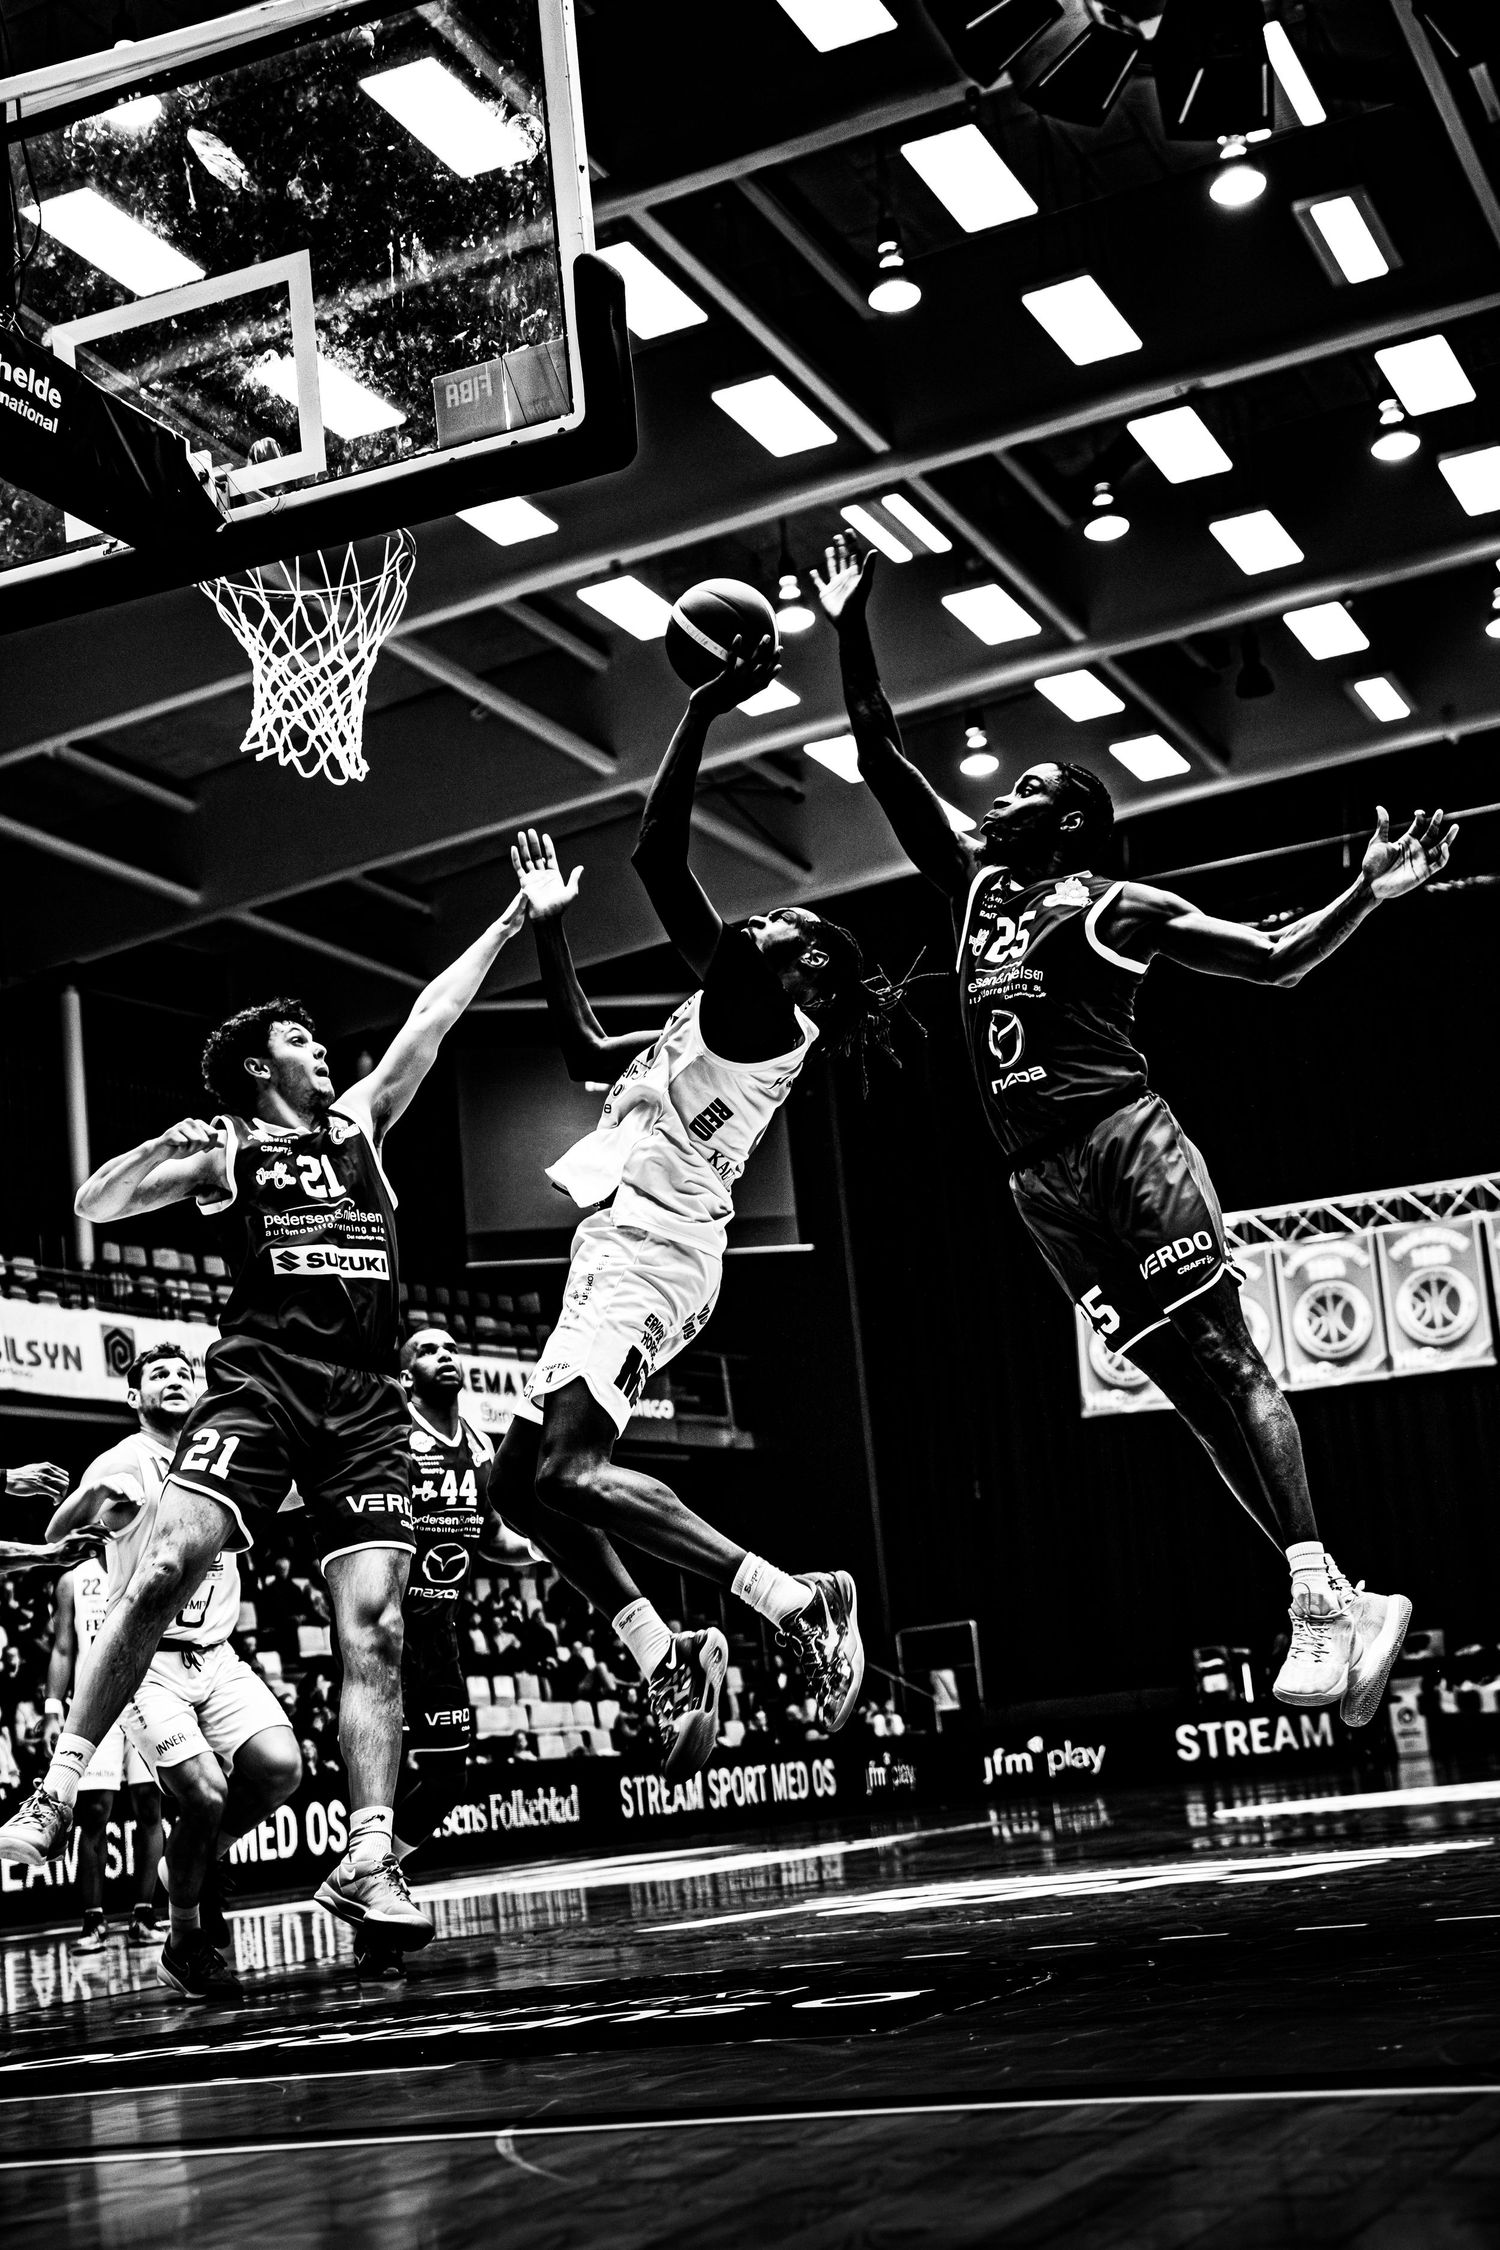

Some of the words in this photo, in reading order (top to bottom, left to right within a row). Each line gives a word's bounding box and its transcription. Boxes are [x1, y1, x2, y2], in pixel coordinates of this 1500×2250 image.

[984, 910, 1036, 963] 25
[260, 1145, 289, 1154] CRAFT
[296, 1154, 347, 1198] 21
[306, 1252, 387, 1273] SUZUKI
[1139, 1231, 1212, 1280] VERDO
[1177, 1257, 1206, 1275] CRAFT
[0, 1335, 83, 1371] ILSYN
[180, 1428, 240, 1480] 21
[440, 1470, 478, 1506] 44
[82, 1579, 100, 1596] 22
[155, 1732, 187, 1756] INNER
[1175, 1712, 1335, 1761] STREAM
[983, 1748, 1033, 1785] jfm
[1047, 1740, 1106, 1778] play
[489, 1784, 580, 1831] Folkeblad
[620, 1770, 704, 1818] STREAM
[709, 1764, 767, 1809] SPORT
[770, 1761, 809, 1802] MED
[812, 1758, 837, 1796] OS
[306, 1799, 348, 1856] OS
